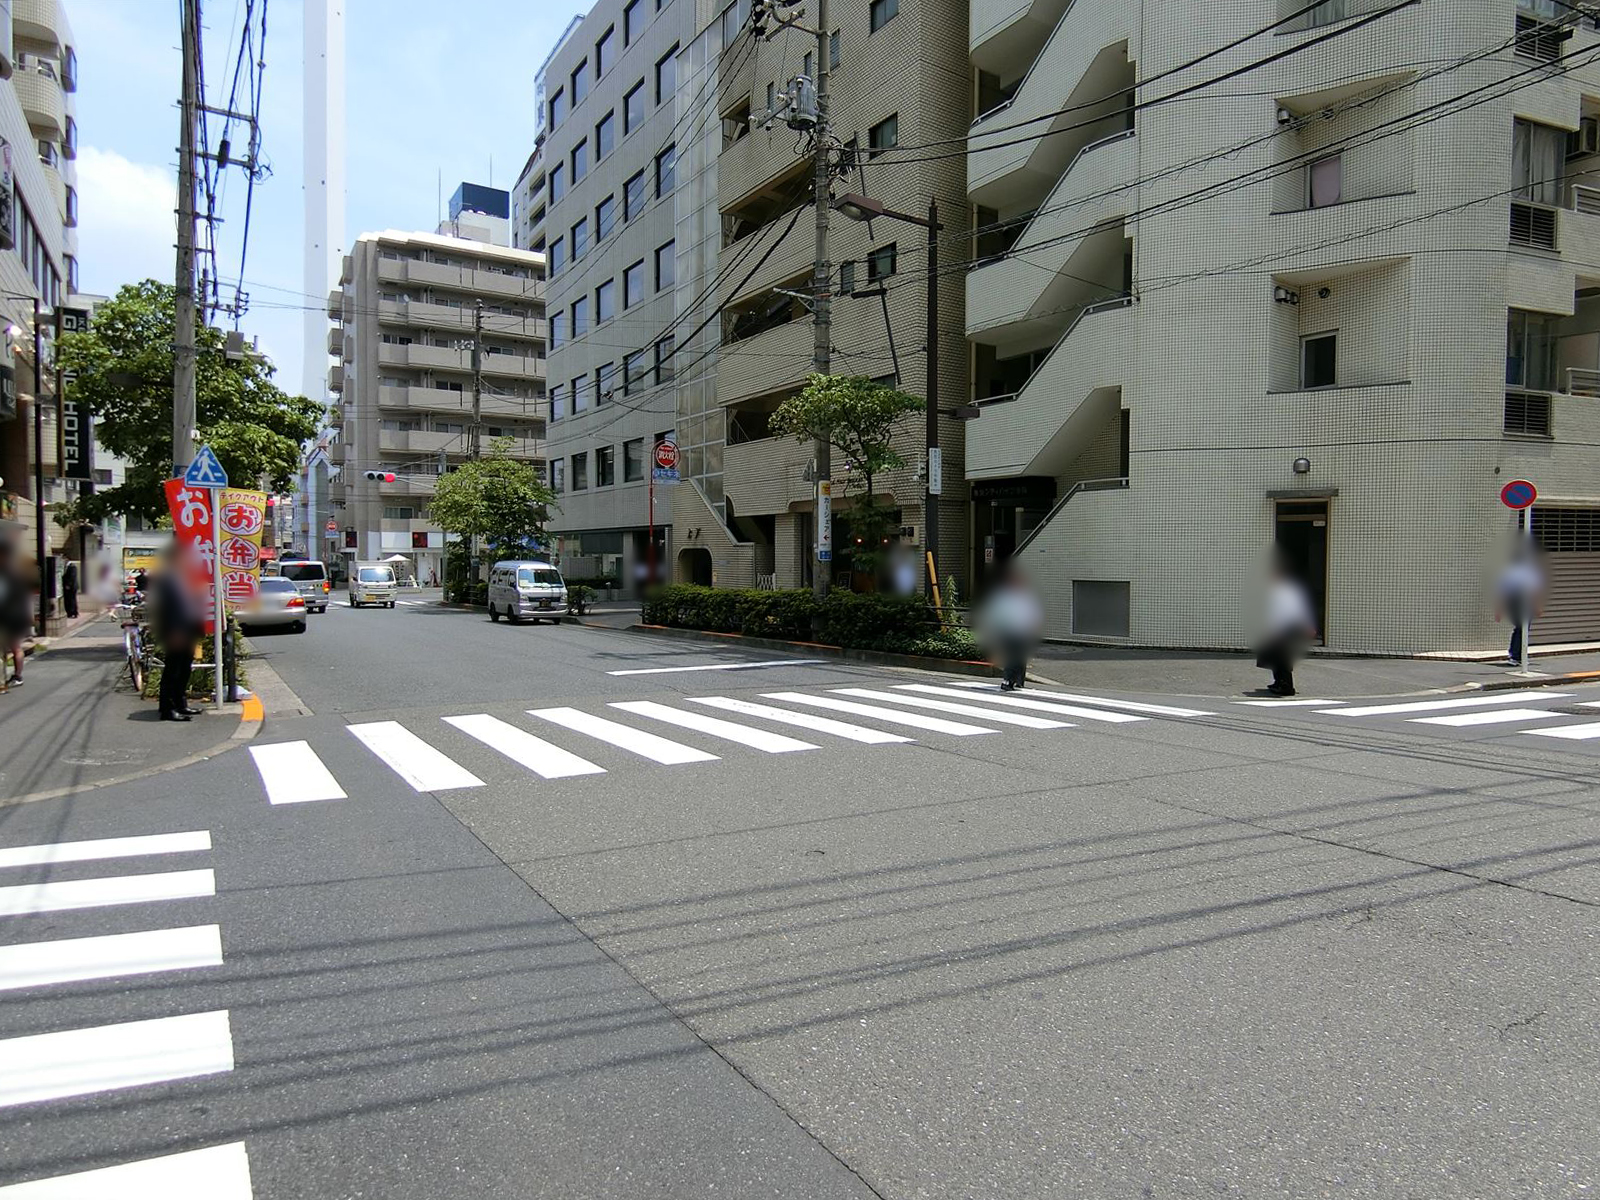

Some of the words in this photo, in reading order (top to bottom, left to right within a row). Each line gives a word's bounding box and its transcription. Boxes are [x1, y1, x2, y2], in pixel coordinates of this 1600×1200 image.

[63, 401, 79, 471] HOTEL
[219, 491, 264, 503] テイクアウト
[223, 504, 257, 599] お弁当
